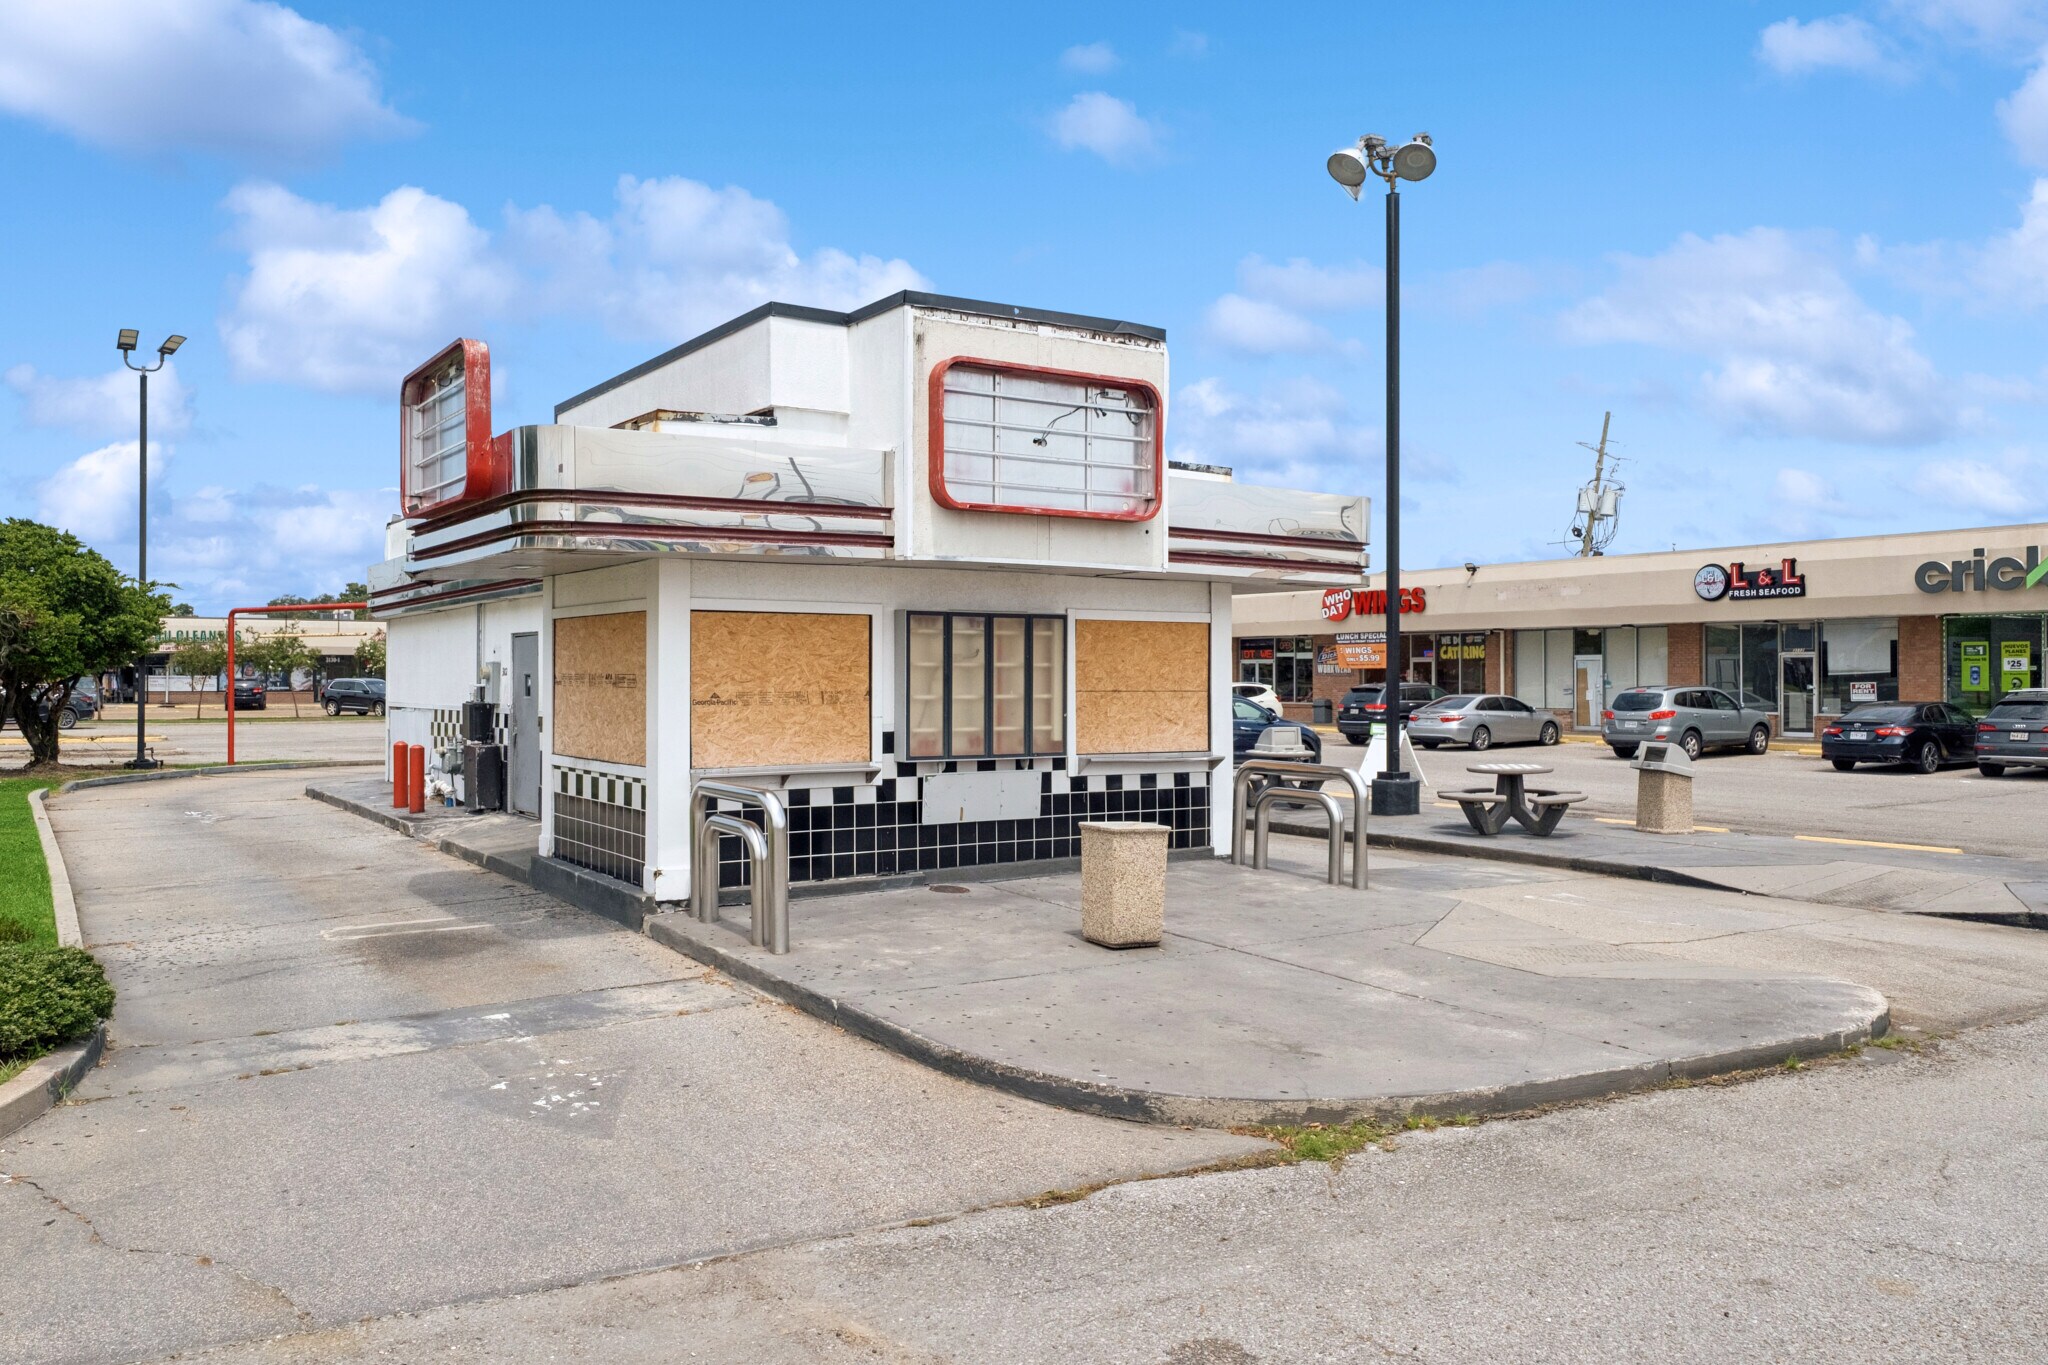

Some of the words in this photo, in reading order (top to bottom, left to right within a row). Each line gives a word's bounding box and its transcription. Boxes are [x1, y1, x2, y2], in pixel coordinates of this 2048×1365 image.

[1730, 563, 1749, 588] L
[1758, 569, 1773, 586] &
[1782, 558, 1801, 585] L
[1324, 590, 1352, 607] WHO
[1758, 587, 1801, 596] SEAFOOD
[1321, 603, 1344, 618] DAT
[2007, 660, 2022, 668] $25
